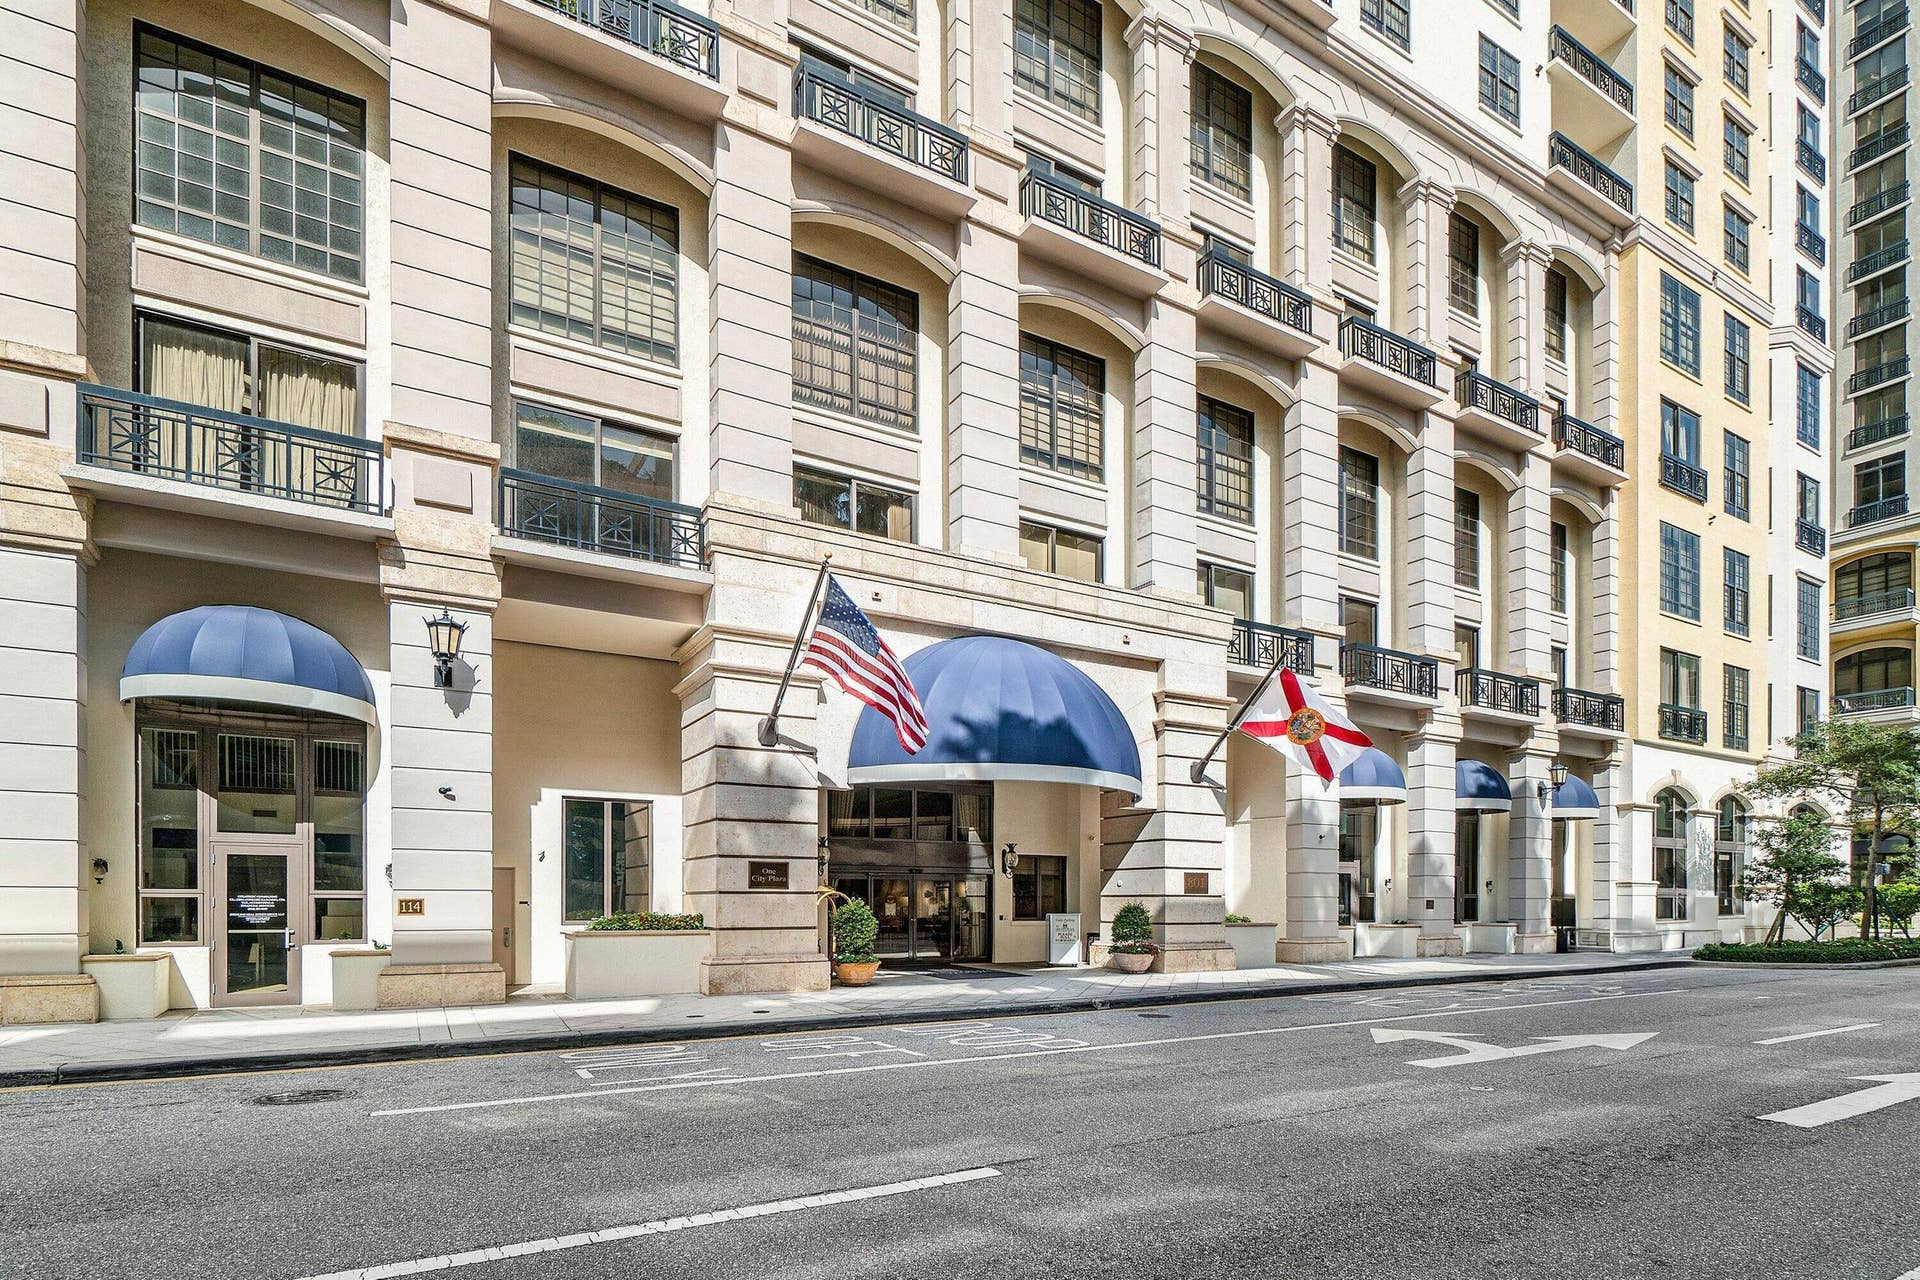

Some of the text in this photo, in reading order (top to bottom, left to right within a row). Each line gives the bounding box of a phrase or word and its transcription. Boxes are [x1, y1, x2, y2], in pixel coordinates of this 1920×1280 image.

[751, 875, 766, 883] City
[1187, 877, 1205, 888] 801
[400, 901, 421, 913] 114
[894, 1022, 1090, 1049] DROP
[760, 1036, 927, 1060] OFF
[558, 1044, 742, 1087] ONLY
